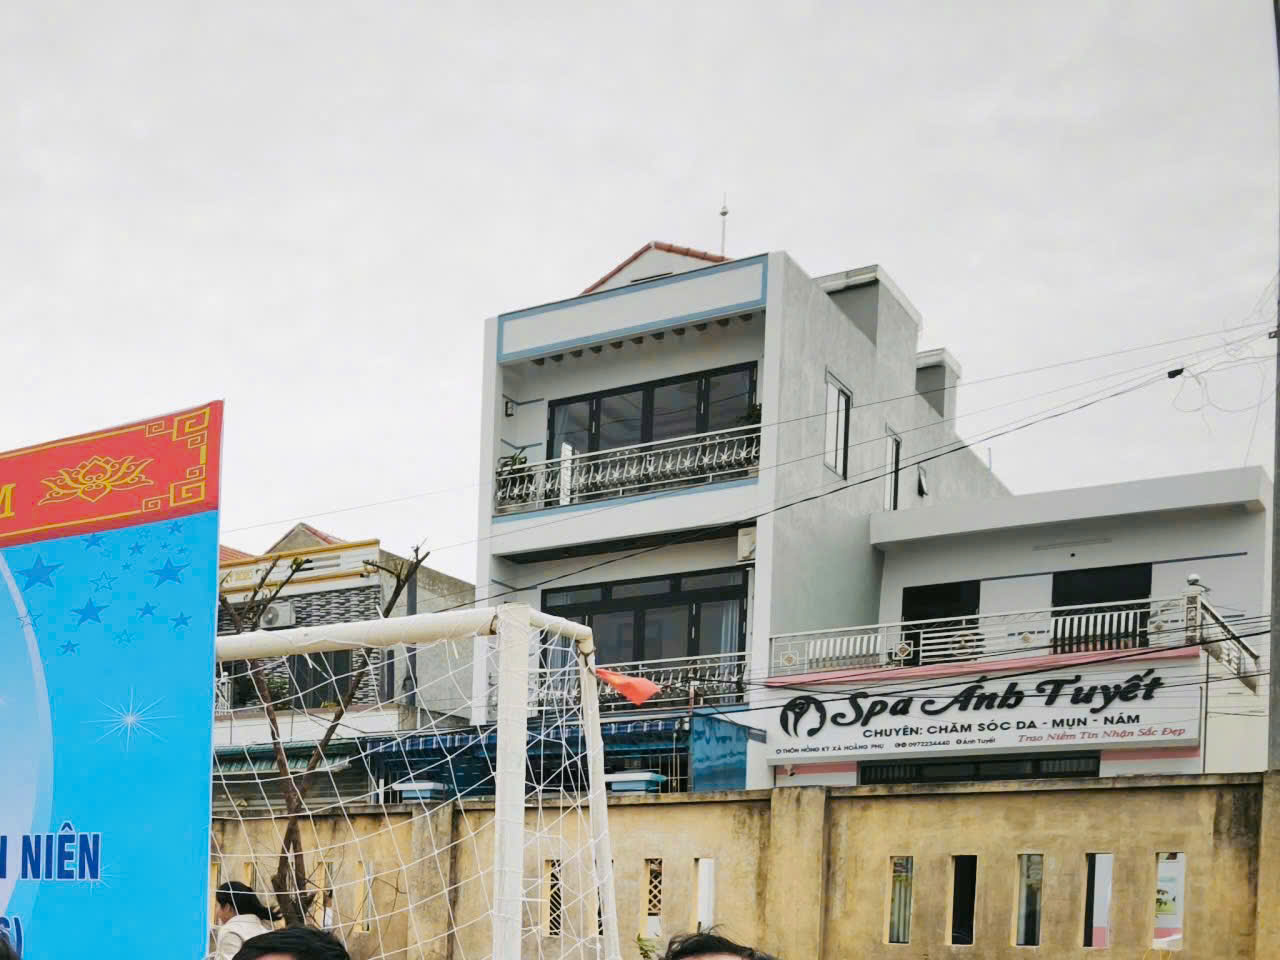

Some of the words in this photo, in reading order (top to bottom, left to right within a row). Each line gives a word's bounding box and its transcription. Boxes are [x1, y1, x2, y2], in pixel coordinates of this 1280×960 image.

[830, 692, 914, 726] Spa
[920, 676, 1024, 715] Ánh
[1036, 668, 1165, 714] Tuyết
[863, 726, 922, 738] CHUYÊN:
[927, 721, 972, 734] CHĂM
[977, 719, 1011, 731] SÓC
[1016, 720, 1038, 730] DA
[1052, 717, 1087, 729] MỤN
[1104, 713, 1140, 725] NÁM
[1018, 734, 1043, 742] Trao
[1079, 731, 1098, 739] Tin
[1161, 728, 1186, 738] Đẹp
[21, 821, 101, 880] NIÊN
